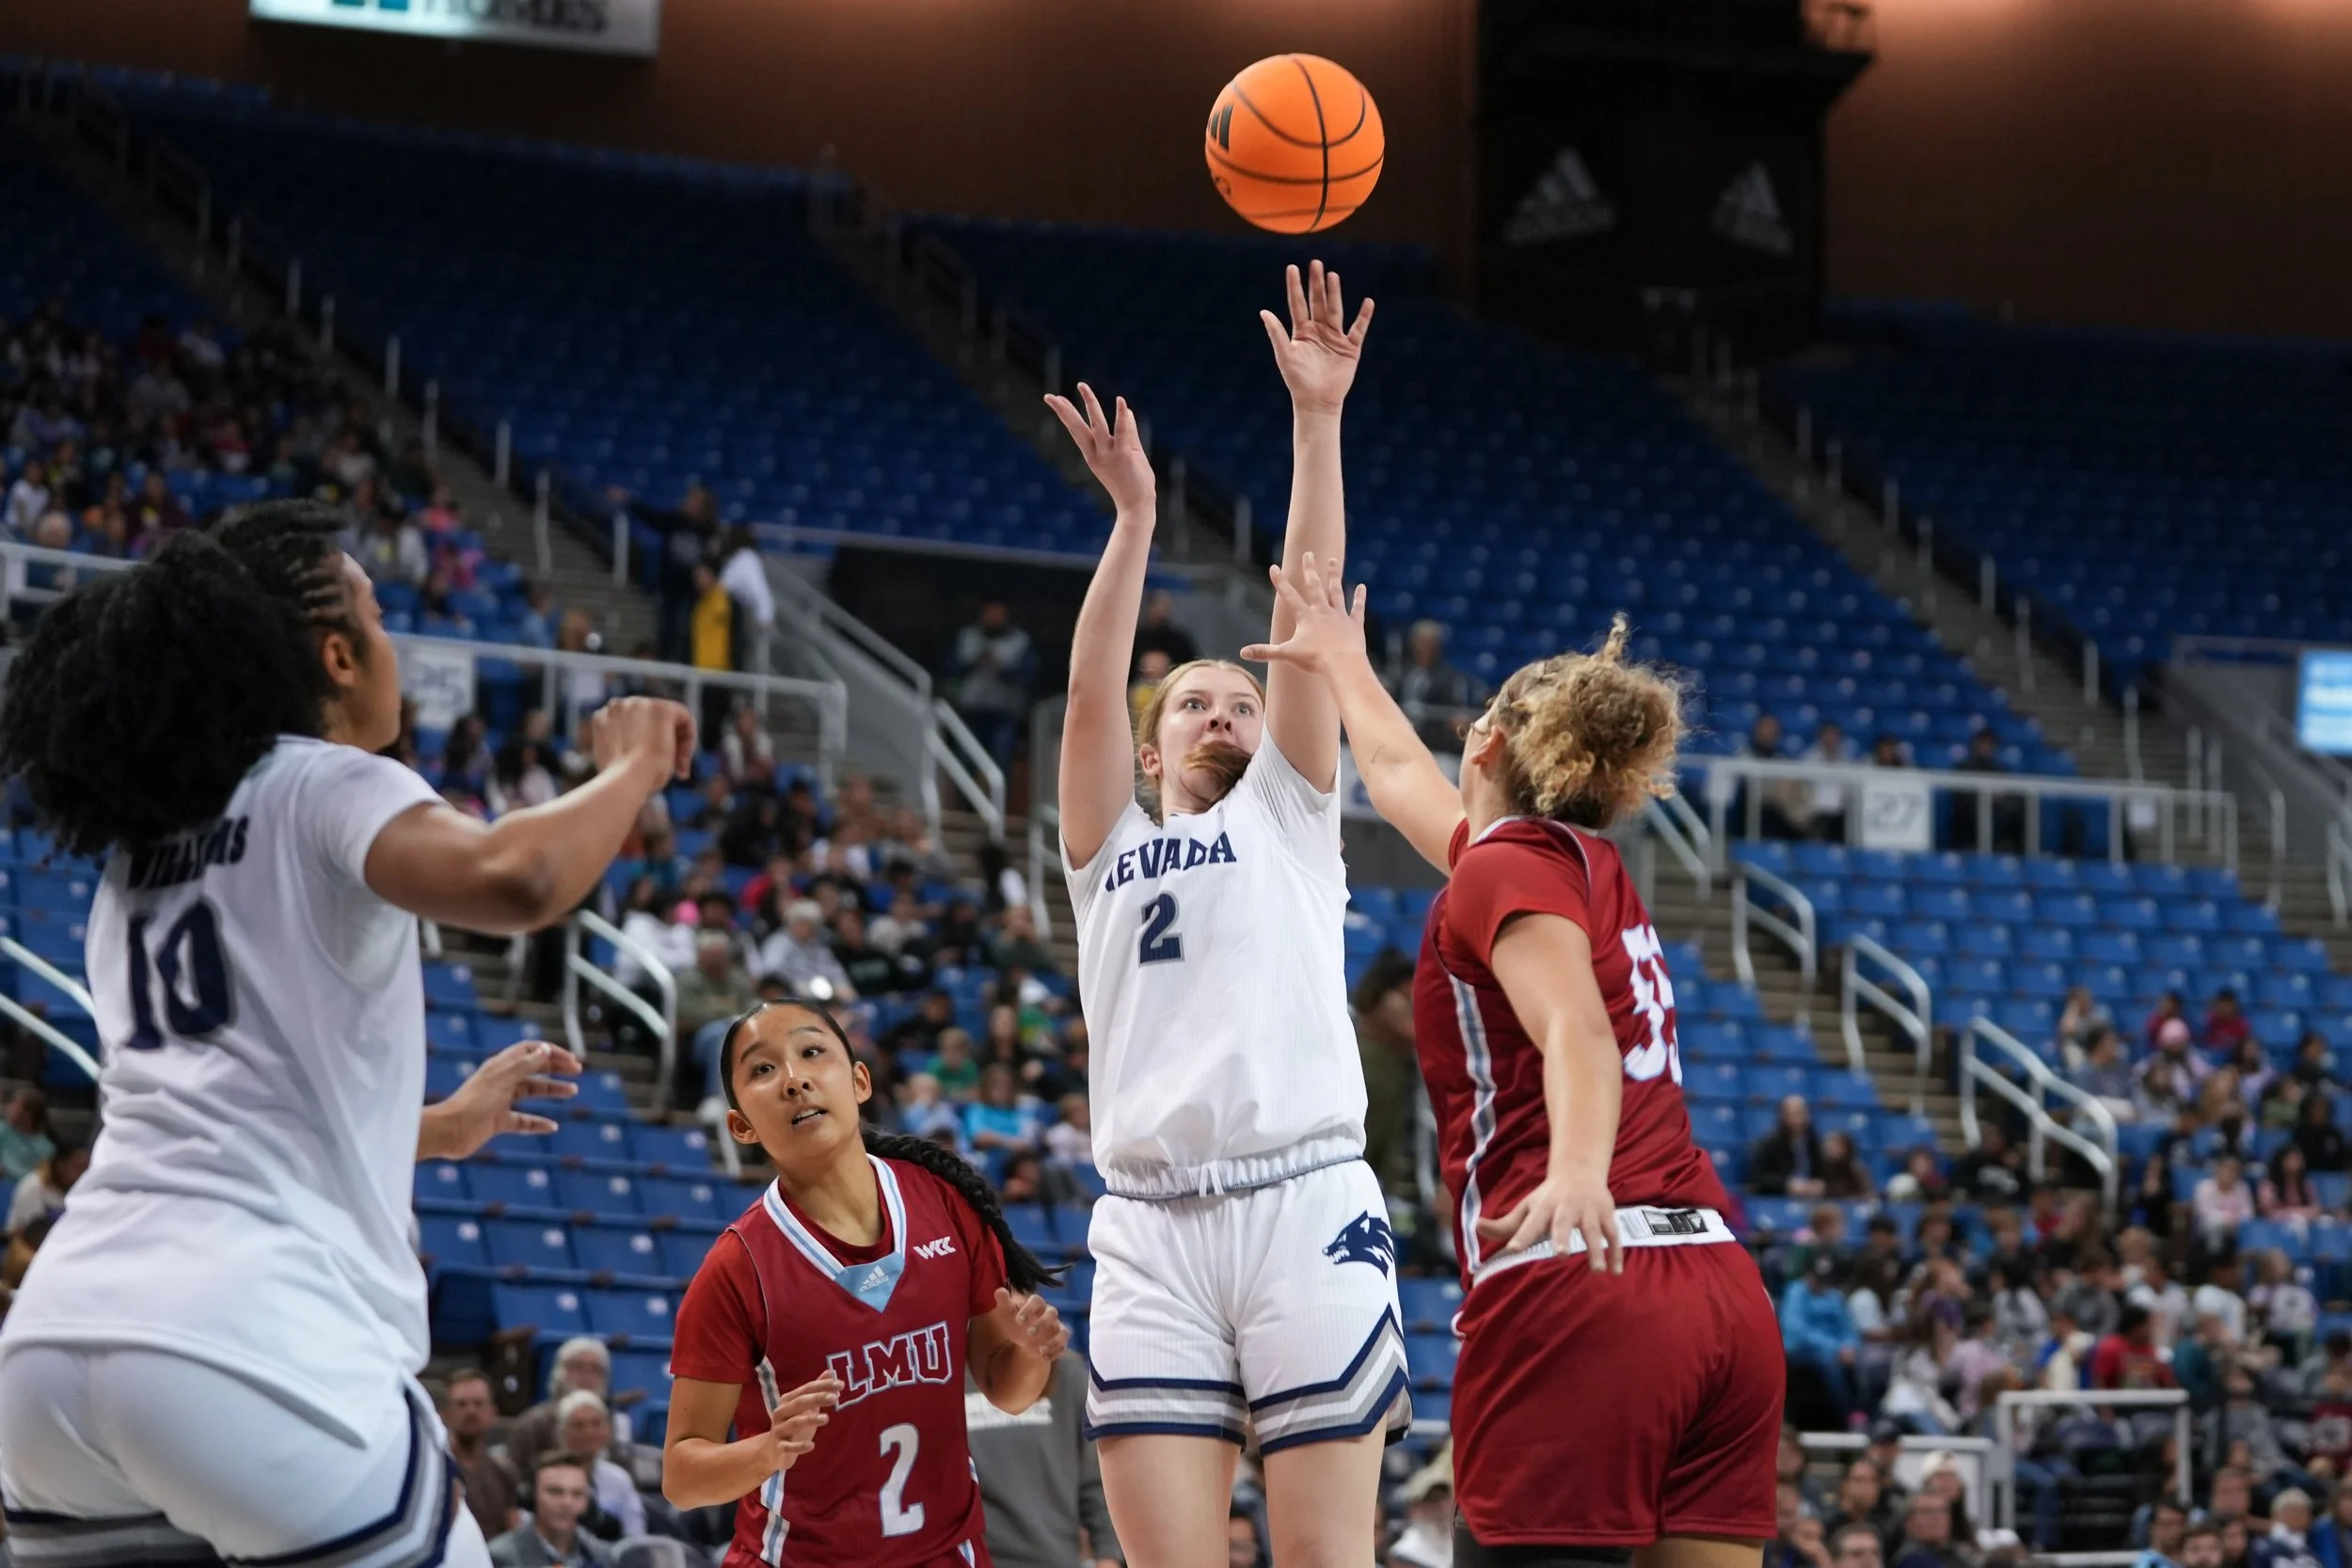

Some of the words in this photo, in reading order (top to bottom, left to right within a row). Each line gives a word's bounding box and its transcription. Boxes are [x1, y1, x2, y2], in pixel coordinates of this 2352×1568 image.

[1865, 791, 1923, 835] 27
[1138, 890, 1185, 967] 2
[126, 895, 235, 1051] 10
[913, 1236, 957, 1260] WCC
[825, 1320, 953, 1412] LMU
[878, 1422, 926, 1538] 2
